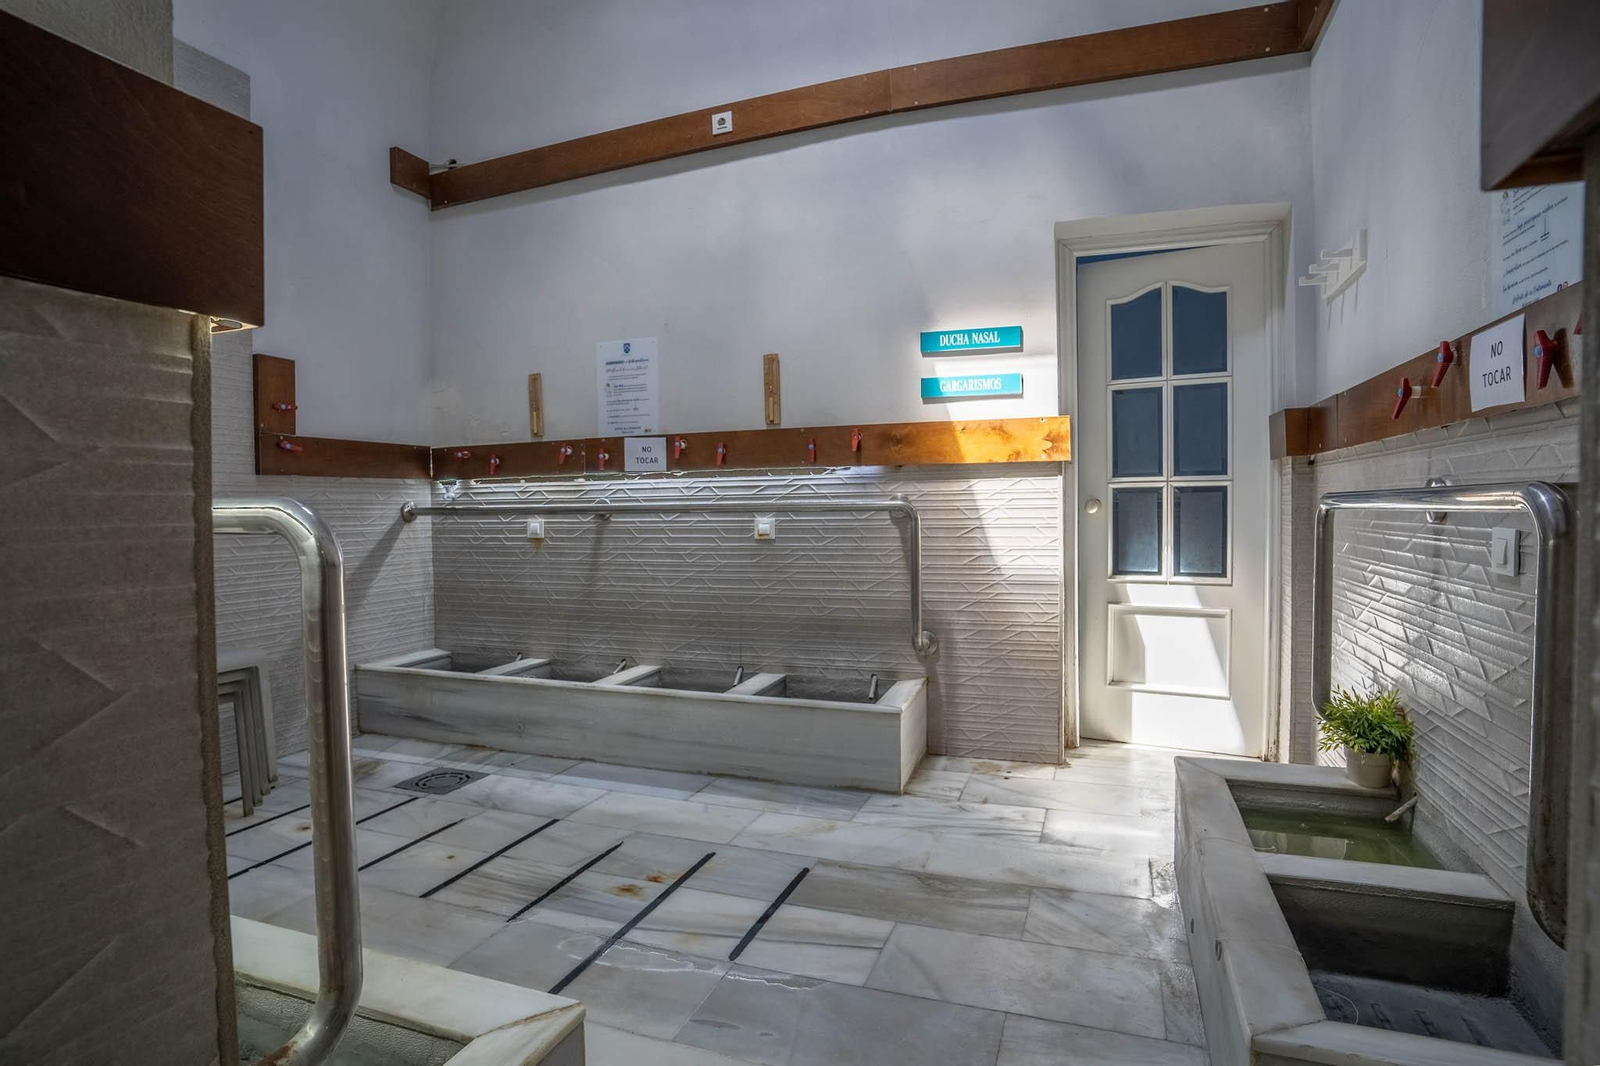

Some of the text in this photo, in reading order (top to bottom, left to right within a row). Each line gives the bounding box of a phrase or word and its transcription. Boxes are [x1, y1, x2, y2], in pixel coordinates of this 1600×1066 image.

[940, 331, 1001, 347] DUCHA NASAL
[1490, 341, 1503, 359] NO
[940, 378, 1002, 392] GARGARISMOS
[1482, 366, 1512, 388] TOCAR
